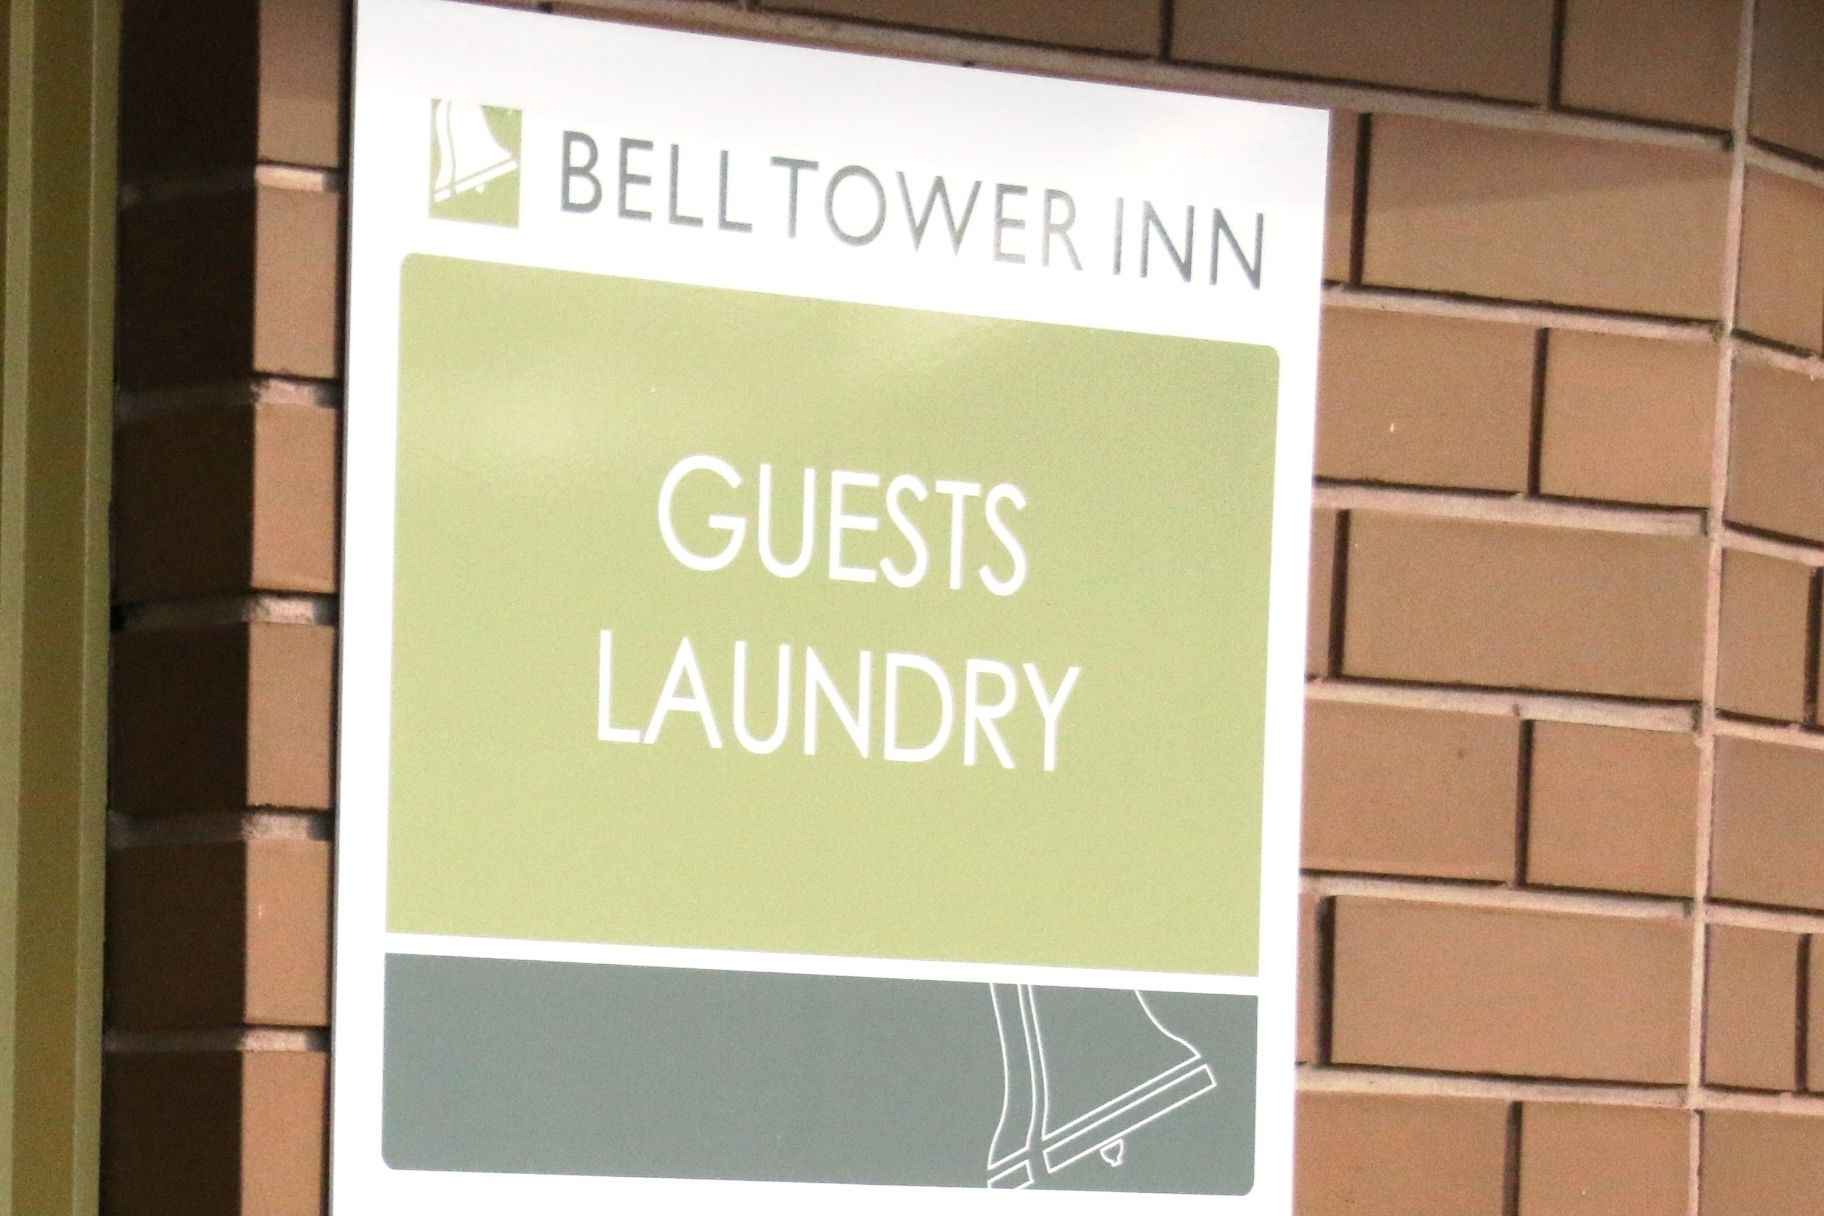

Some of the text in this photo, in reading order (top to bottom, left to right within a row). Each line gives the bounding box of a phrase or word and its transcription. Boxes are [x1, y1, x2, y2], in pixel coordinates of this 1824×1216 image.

[560, 129, 1265, 291] BELL TOWER INN
[656, 453, 1029, 597] GUESTS
[596, 628, 1082, 771] LAUNDRY
